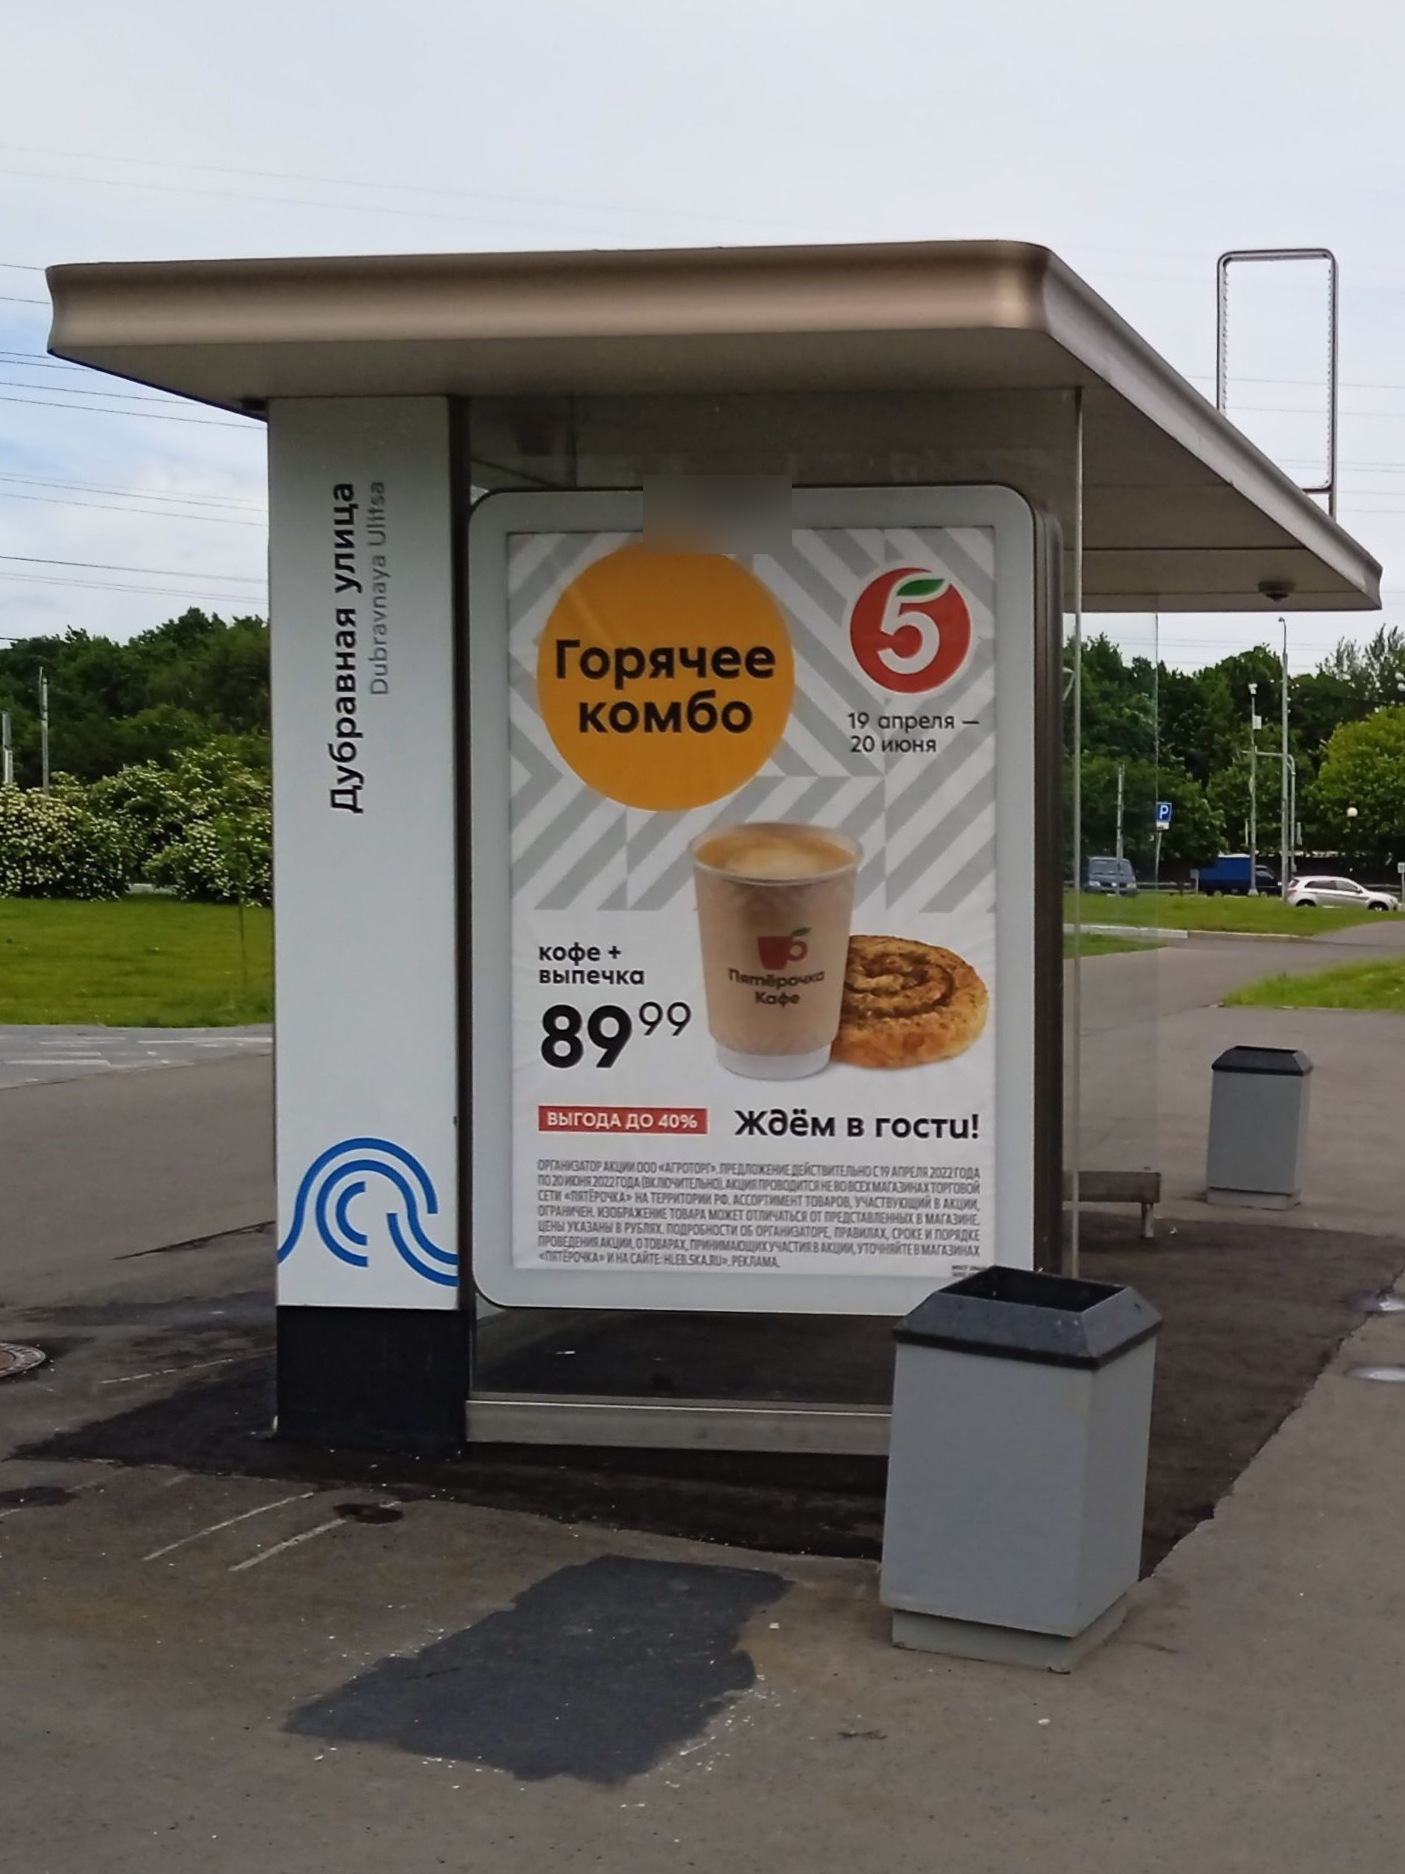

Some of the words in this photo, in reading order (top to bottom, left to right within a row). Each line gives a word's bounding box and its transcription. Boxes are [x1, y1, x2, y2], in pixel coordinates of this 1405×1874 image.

[366, 481, 387, 548] Ulitsa
[332, 482, 362, 594] улица
[367, 554, 391, 695] Dubravnaya
[555, 638, 776, 690] Горячее
[328, 607, 364, 814] Дубравная
[577, 689, 754, 734] комбо
[848, 711, 869, 731] 19
[877, 714, 955, 733] апреля
[849, 735, 875, 754] 20
[881, 738, 937, 754] июня
[539, 942, 601, 966] кофе
[539, 969, 645, 985] выпечка
[728, 967, 825, 990] Пятёрочка
[755, 991, 801, 1008] Кафе
[541, 1004, 633, 1069] 89
[639, 1001, 692, 1036] 99
[547, 1111, 622, 1129] ВЫГОДА
[625, 1113, 654, 1130] ДО
[657, 1114, 699, 1129] 40%
[734, 1108, 836, 1137] Ждём
[847, 1117, 865, 1137] в
[875, 1114, 980, 1139] гости!
[538, 1160, 602, 1171] ОРГАНИЗАТОР
[603, 1161, 635, 1173] АКЦИИ
[637, 1161, 657, 1172] ООО
[891, 1165, 928, 1177] АПРЕЛЯ
[929, 1166, 953, 1177] 2022
[954, 1167, 980, 1179] ГОДА
[538, 1175, 551, 1186] ПО
[593, 1176, 615, 1187] 2022
[616, 1176, 640, 1189] ГОДА
[538, 1190, 562, 1201] СЕТИ
[635, 1192, 648, 1203] НА
[650, 1192, 712, 1204] ТЕРРИТОРИИ
[733, 1194, 802, 1206] АССОРТИМЕНТ
[597, 1207, 667, 1219] ИЗОБРАЖЕНИЕ
[669, 1208, 707, 1219] ТОВАРА
[709, 1209, 744, 1220] МОЖЕТ
[746, 1209, 808, 1221] ОТЛИЧАТЬСЯ
[538, 1221, 565, 1234] ЦЕНЫ
[568, 1222, 613, 1233] УКАЗАНЫ
[666, 1223, 738, 1237] ПОДРОБНОСТИ
[740, 1224, 753, 1235] ОБ
[892, 1227, 923, 1238] СРОКЕ
[934, 1228, 980, 1241] ПОРЯДКЕ
[615, 1252, 628, 1263] НА
